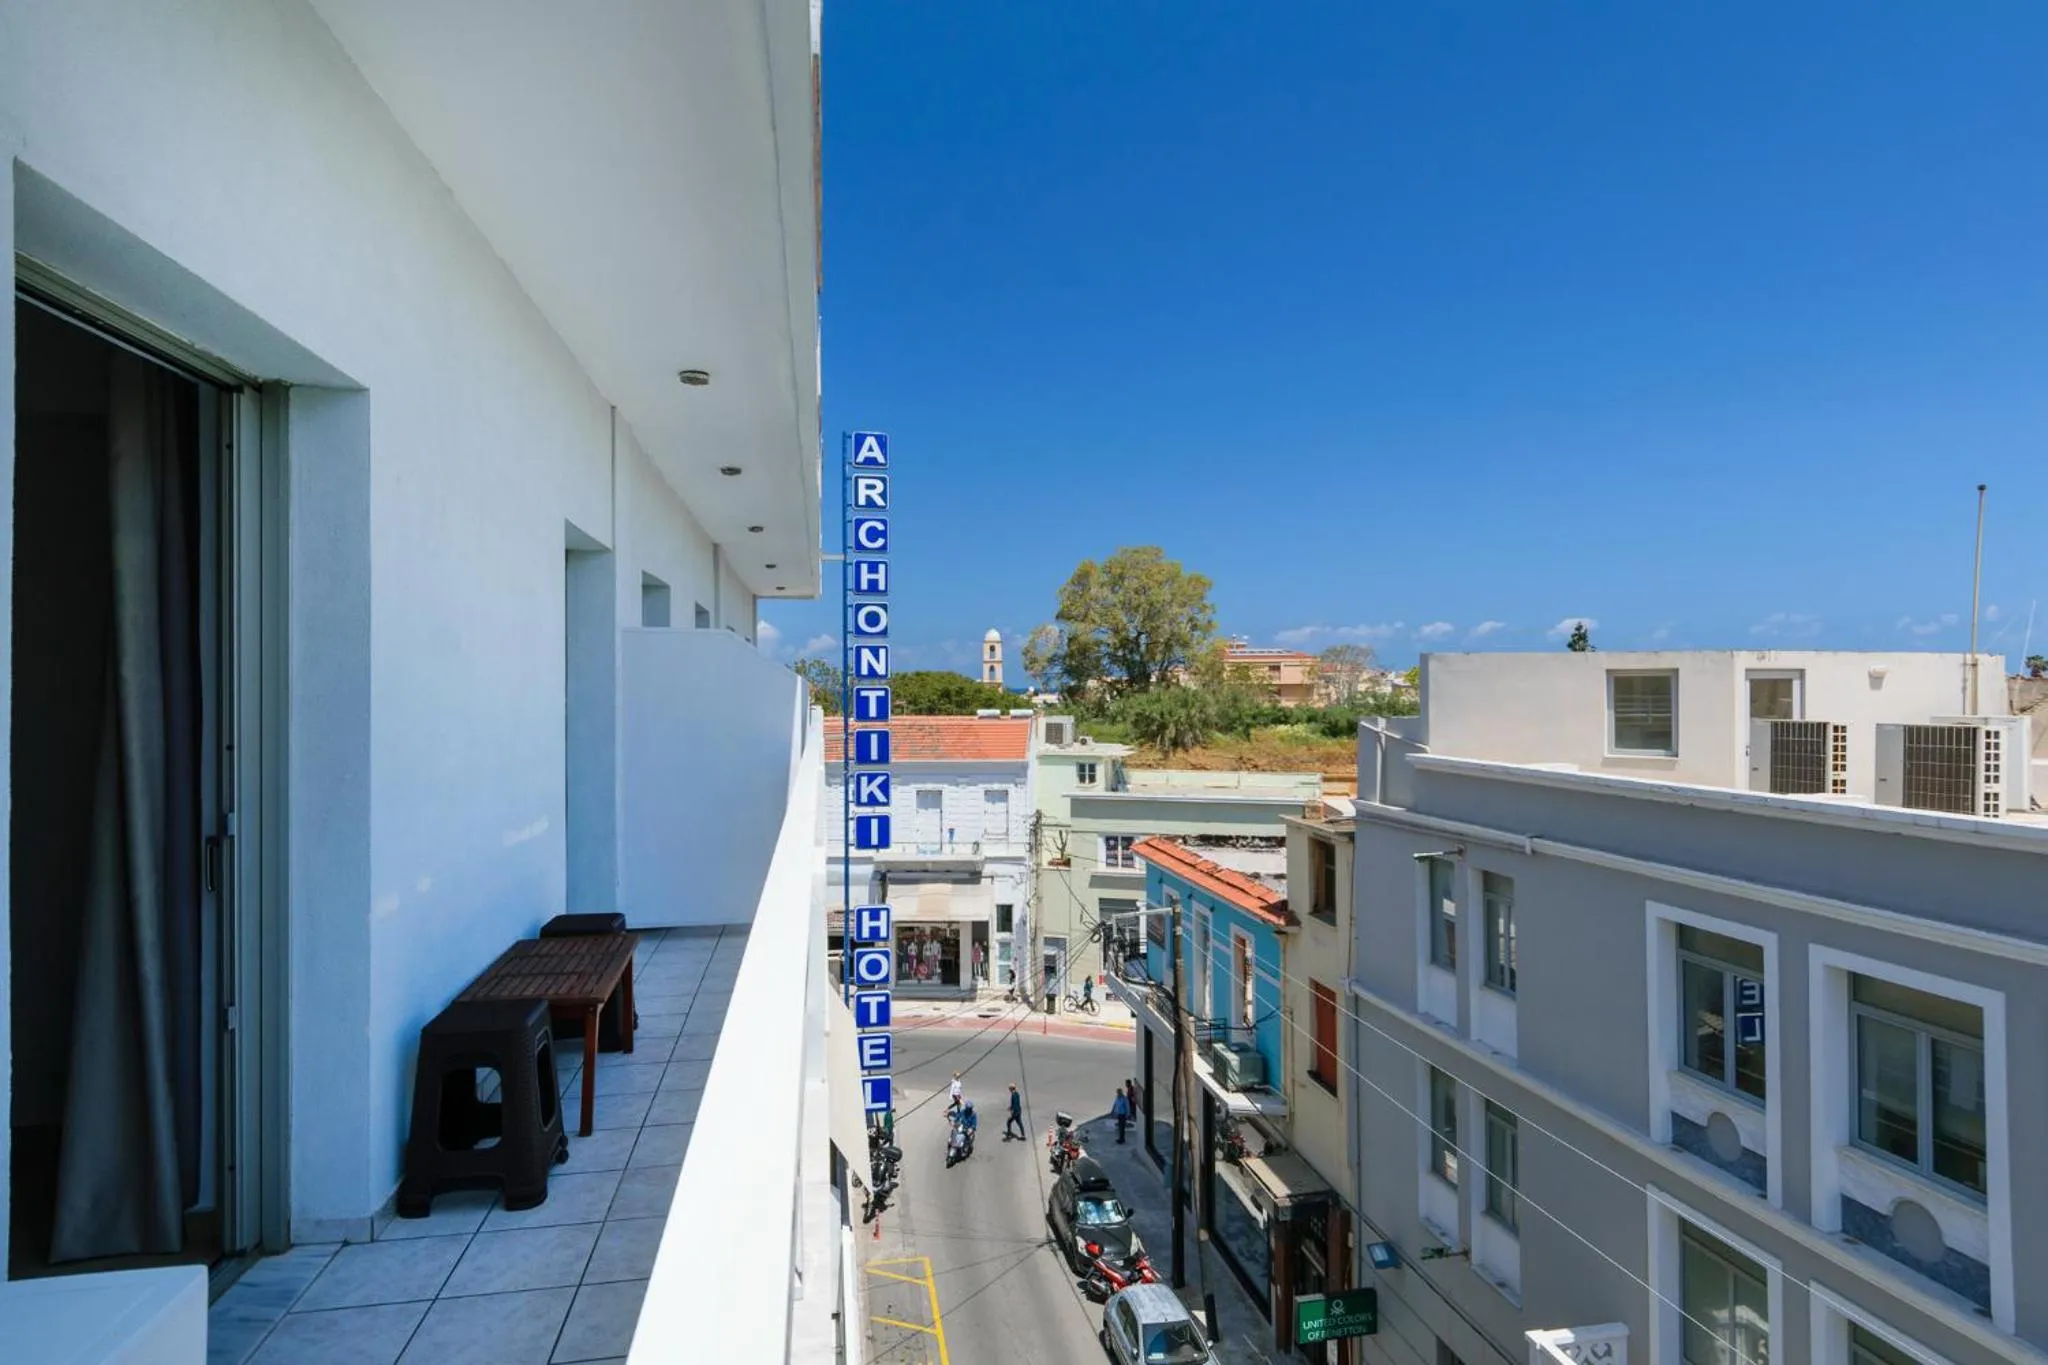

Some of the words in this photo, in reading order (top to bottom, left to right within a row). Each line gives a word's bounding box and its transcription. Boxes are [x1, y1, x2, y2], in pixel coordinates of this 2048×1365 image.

[855, 435, 888, 846] ARCHONTIKI
[858, 910, 889, 1110] HOTEL
[1302, 1317, 1336, 1330] UNITED
